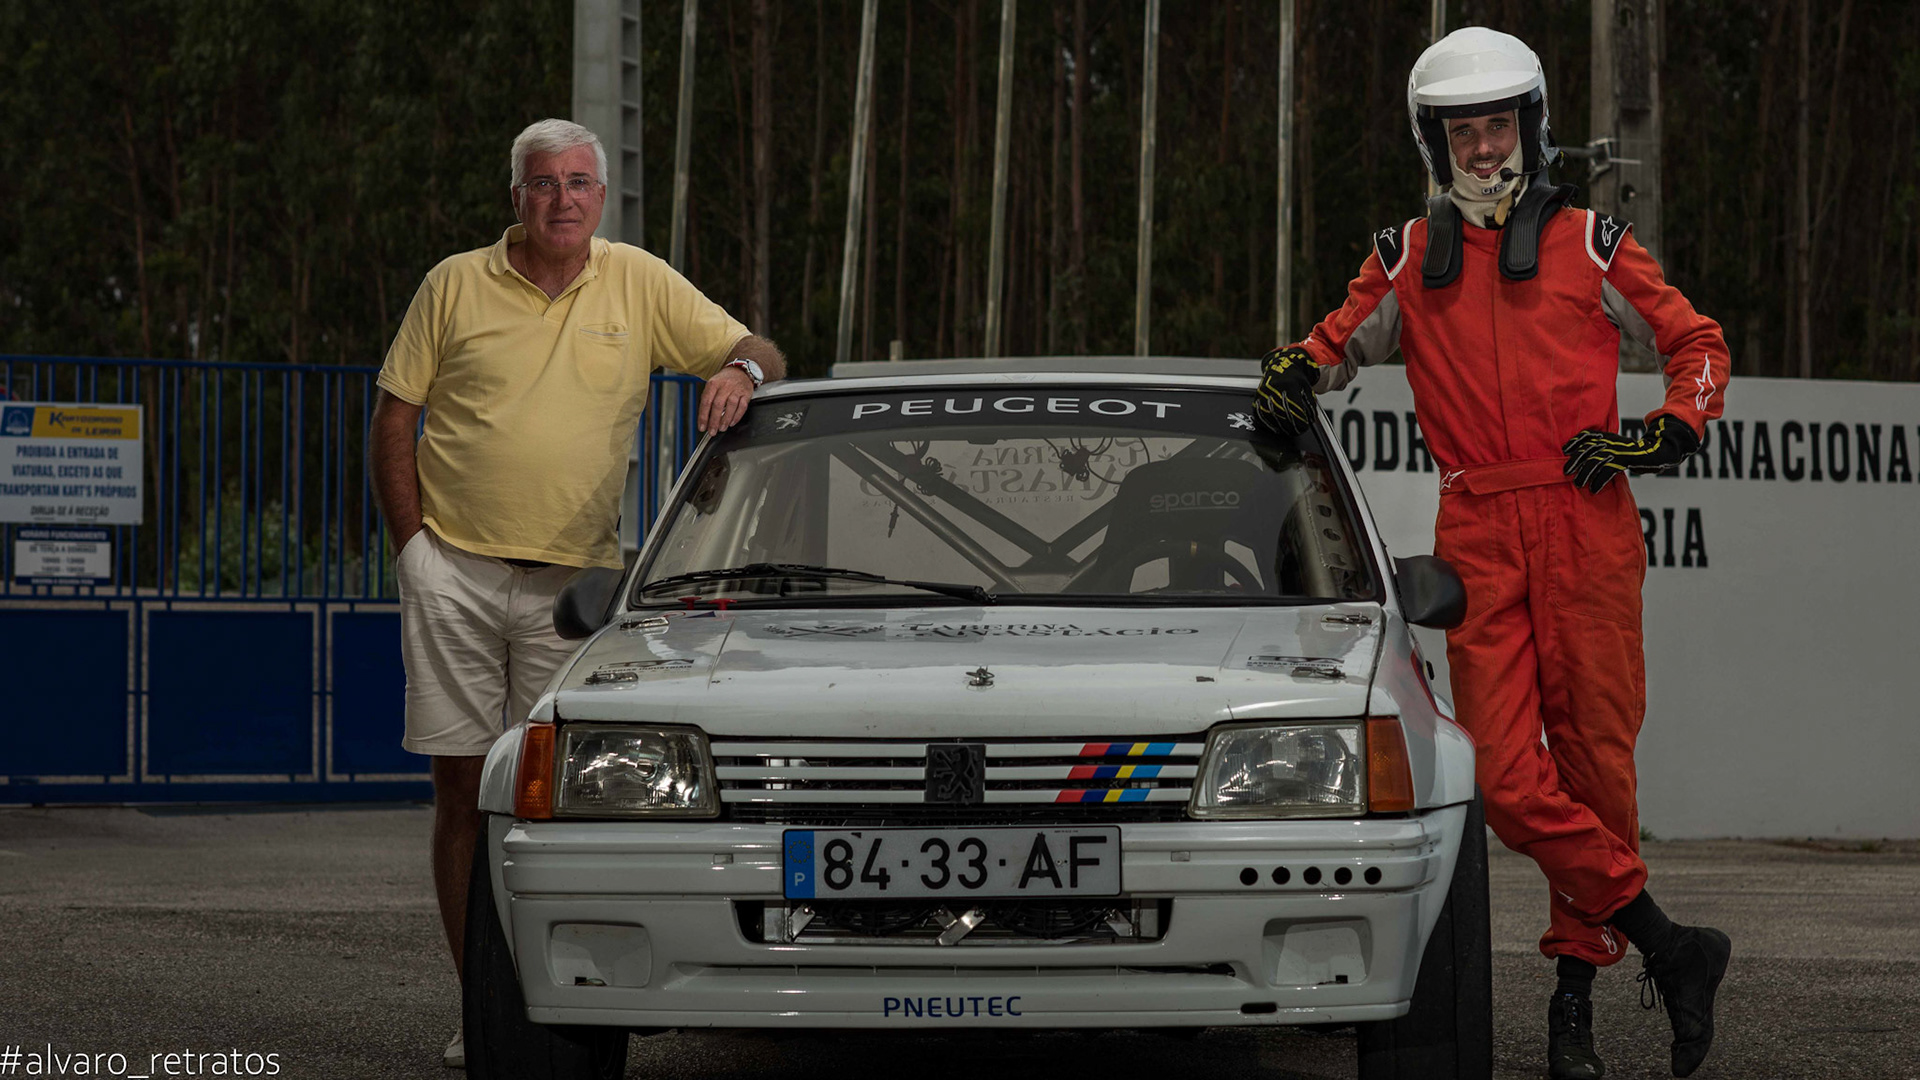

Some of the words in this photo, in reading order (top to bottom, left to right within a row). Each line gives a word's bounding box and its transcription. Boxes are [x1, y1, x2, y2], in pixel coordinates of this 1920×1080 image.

[852, 397, 1182, 420] PEUGEOT
[16, 445, 56, 458] PROIBIDA
[59, 446, 65, 458] A
[67, 446, 105, 459] ENTRADA
[107, 447, 118, 460] DE
[58, 465, 90, 478] EXCETO
[92, 466, 104, 478] AS
[105, 466, 123, 479] QUE
[0, 484, 60, 497] TRANSPORTAM
[1150, 490, 1240, 513] sparco
[1640, 508, 1708, 567] RIA
[794, 872, 805, 887] P
[884, 996, 1022, 1017] PNEUTEC
